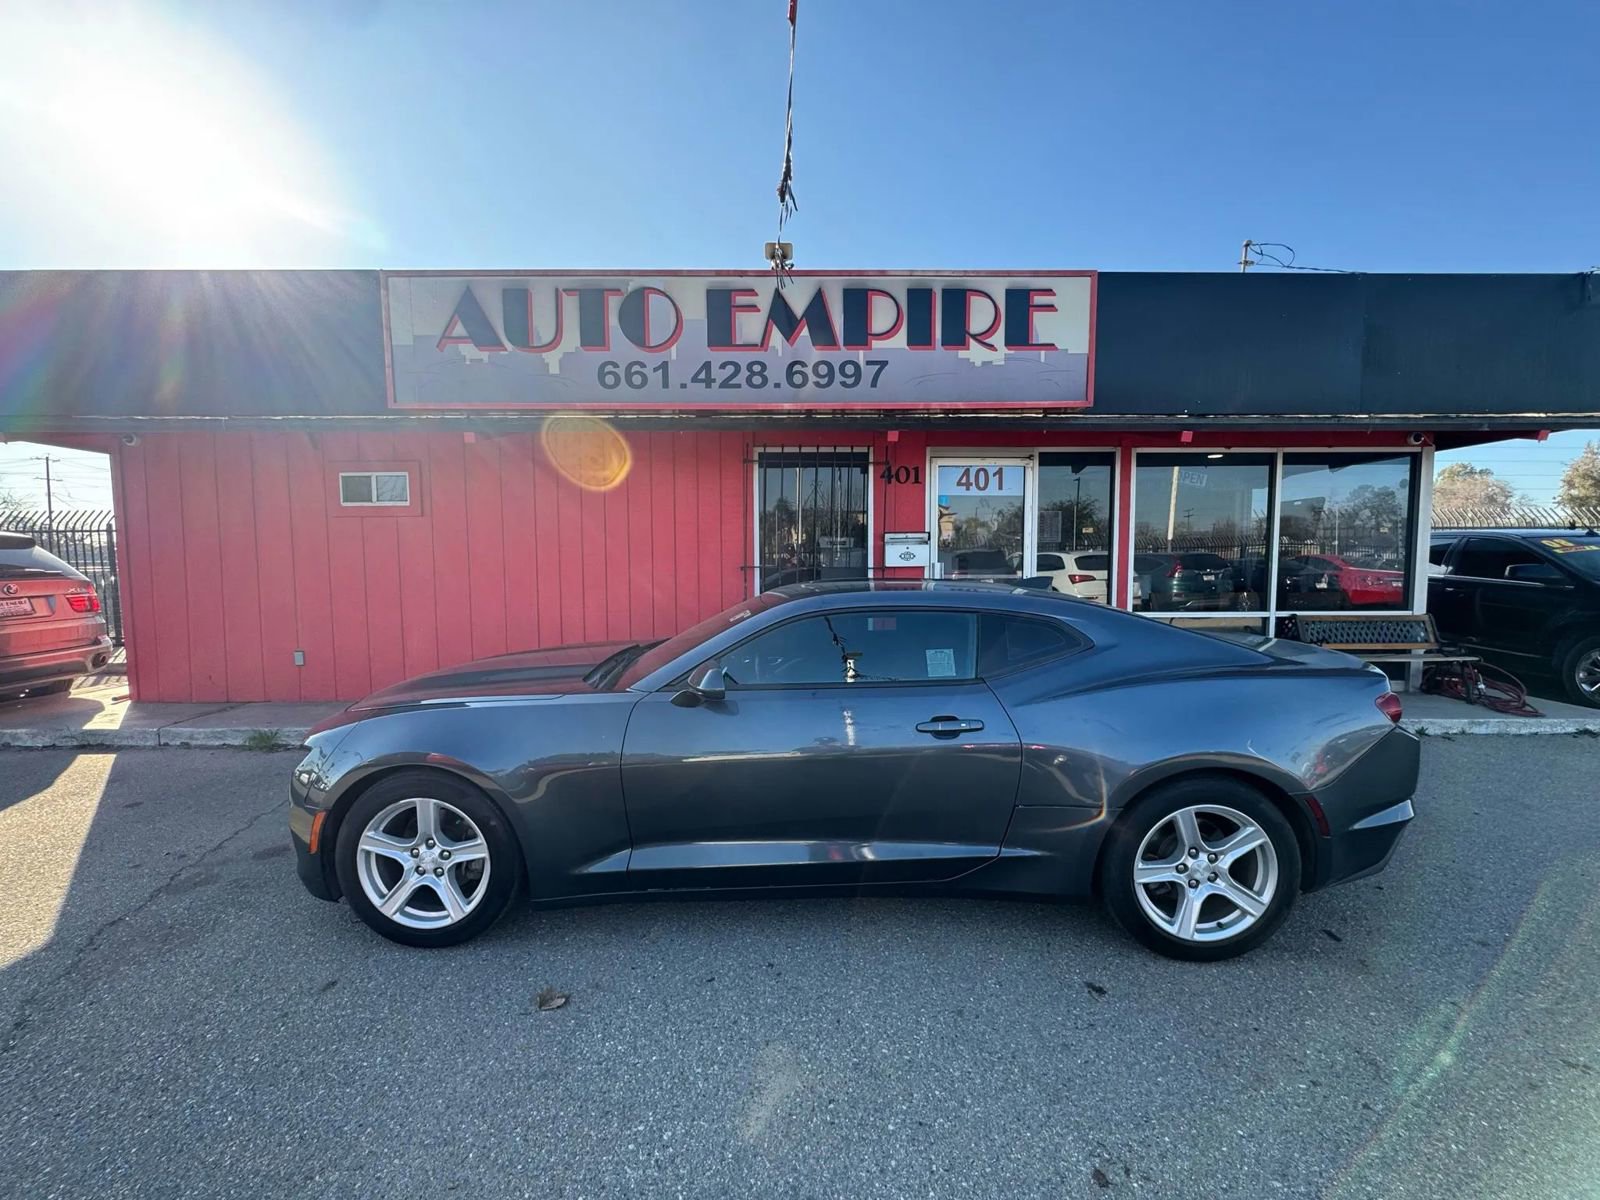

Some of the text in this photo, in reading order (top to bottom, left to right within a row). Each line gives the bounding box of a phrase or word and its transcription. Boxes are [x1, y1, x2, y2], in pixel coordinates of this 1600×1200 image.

[436, 285, 1059, 353] AUTO EMPIRE
[597, 360, 889, 390] 661.428.6997
[880, 464, 922, 485] 401
[956, 467, 1004, 491] 401
